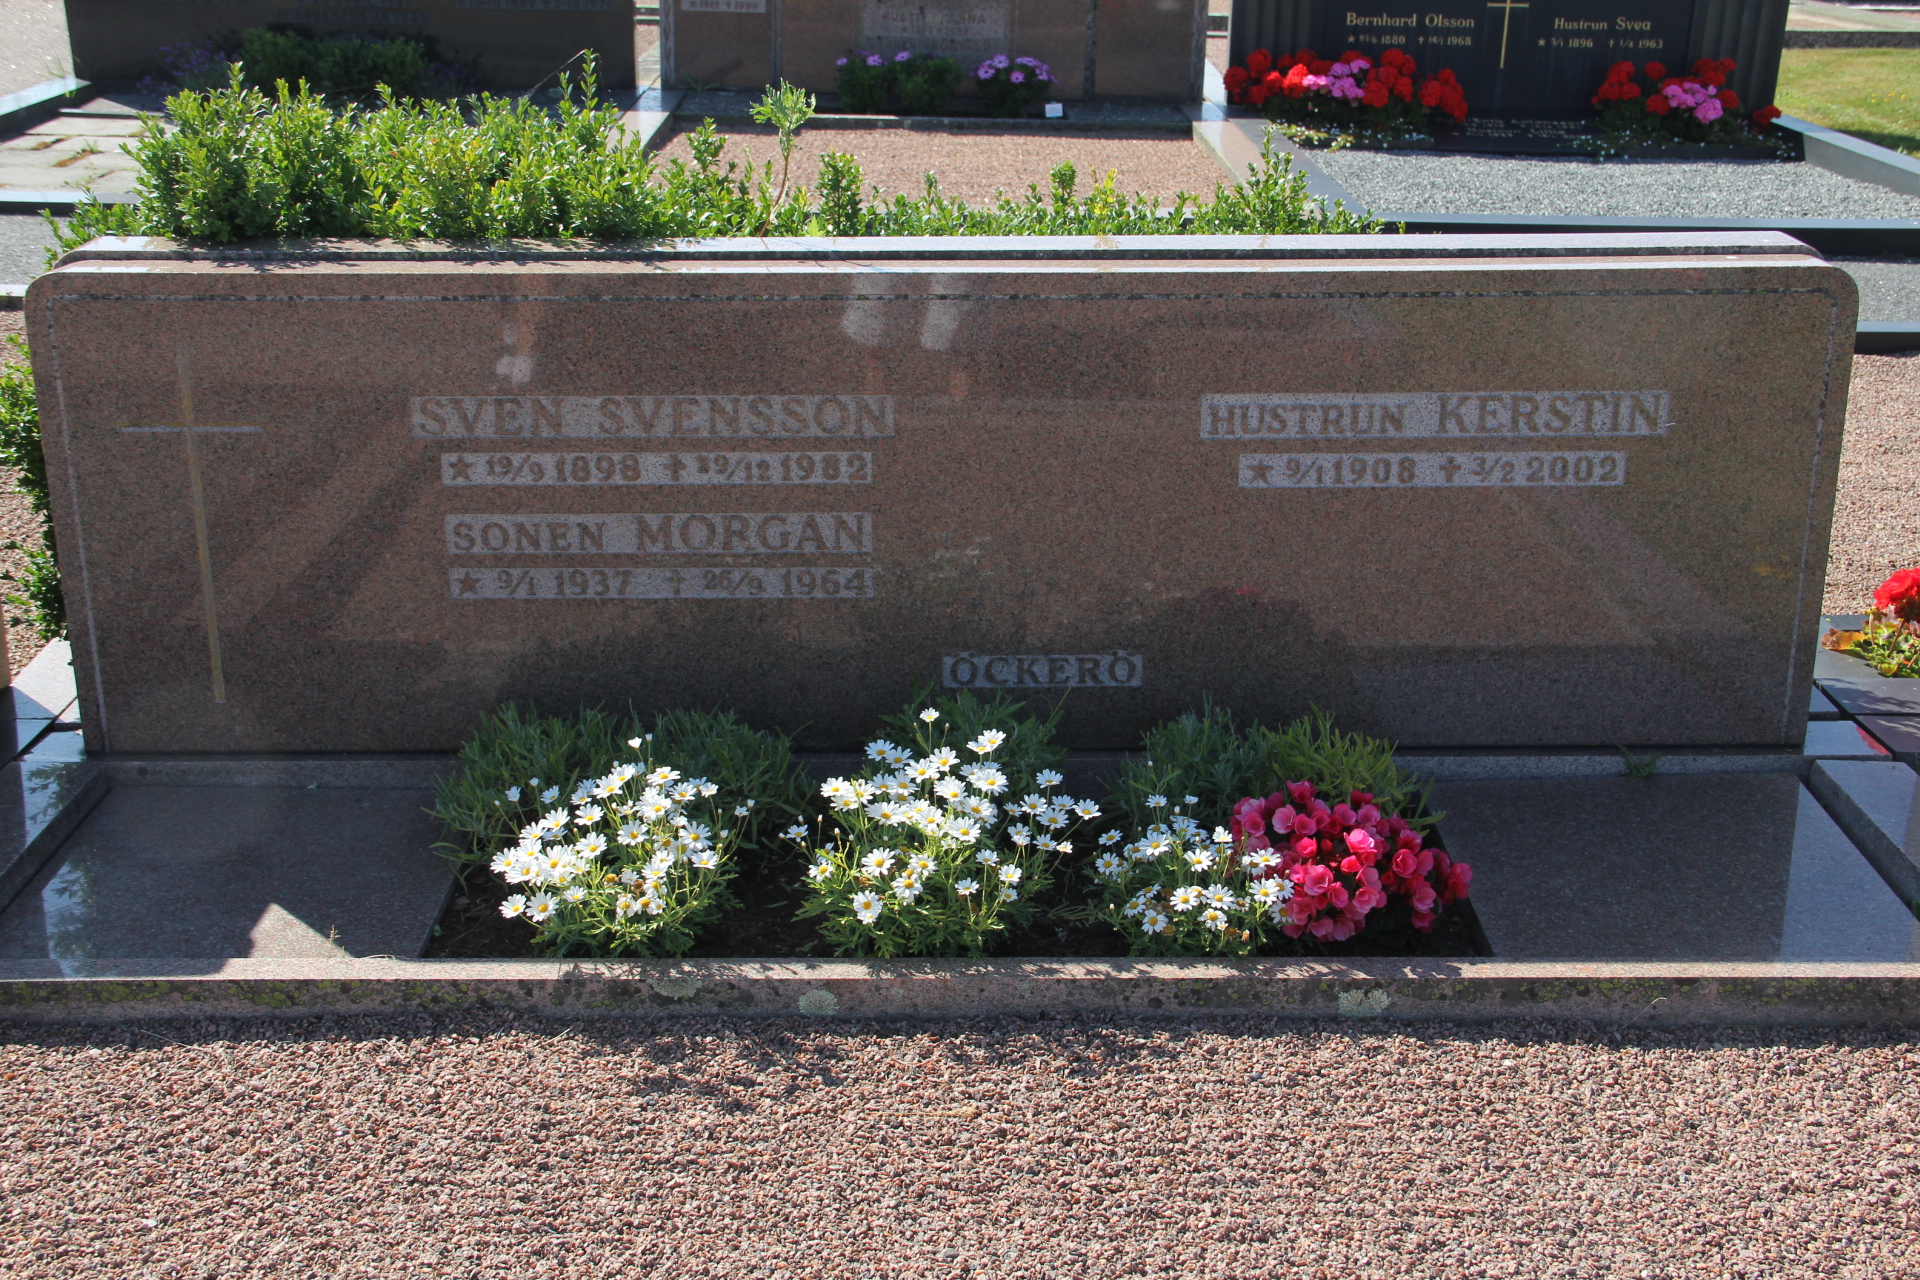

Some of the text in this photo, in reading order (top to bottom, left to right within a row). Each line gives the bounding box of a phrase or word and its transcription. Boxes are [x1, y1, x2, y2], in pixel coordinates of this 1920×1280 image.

[735, 1, 760, 11] 1999
[947, 12, 988, 25] ANNA
[1345, 12, 1475, 28] Bernhard Olsson
[1553, 16, 1652, 31] Hustrun Svea
[1381, 35, 1406, 45] 1880
[1447, 36, 1472, 46] 1968
[1568, 38, 1594, 48] 1896
[1638, 39, 1664, 49] 1963
[418, 396, 892, 437] SVEN SVENSSON
[1207, 393, 1664, 435] HUSTRUN KERSTIN
[485, 453, 869, 482] 19/9 1898 29/12 1982
[1285, 455, 1619, 485] 9/1 1908 3/2 2002
[452, 514, 867, 552] SONEN MORGAN
[496, 568, 869, 597] 9/1 1937 26/9 1964
[949, 650, 1137, 687] ÖCKERÖ
